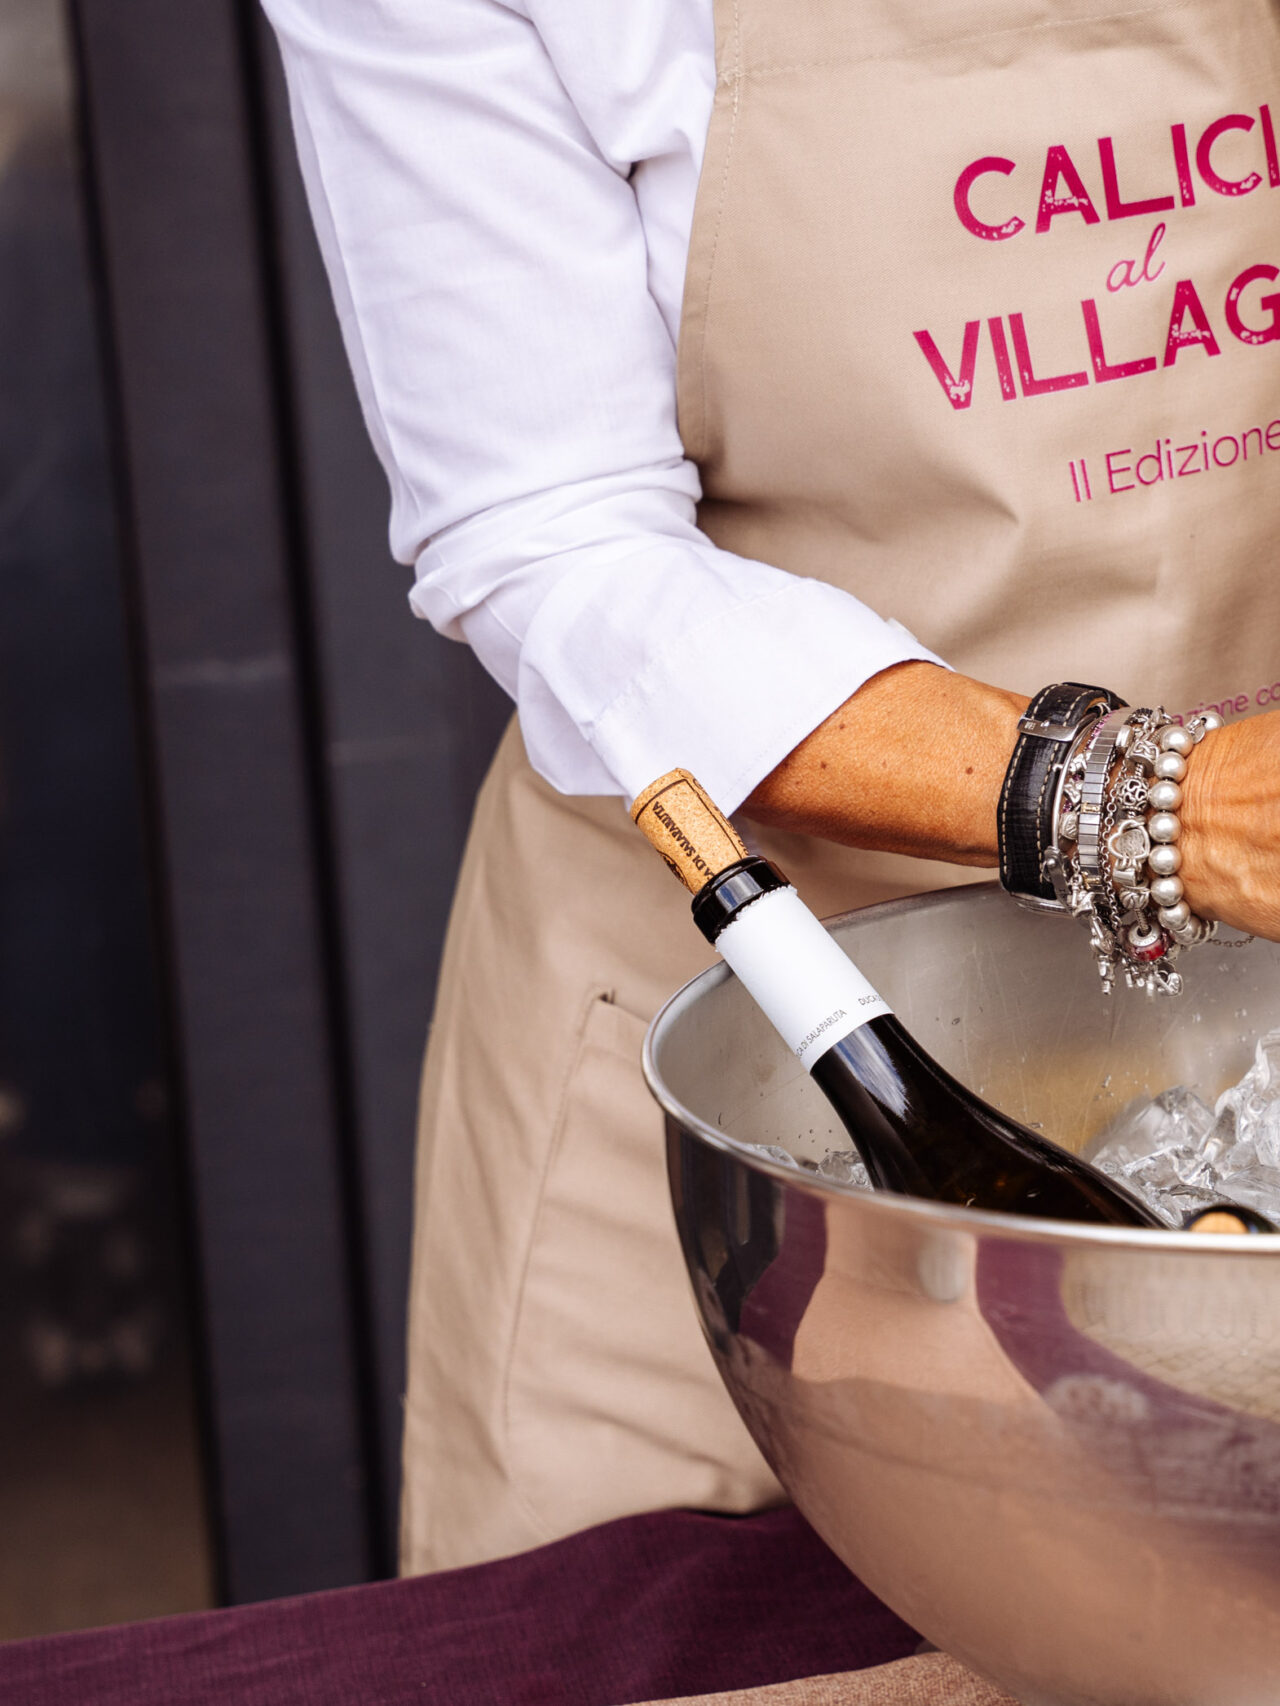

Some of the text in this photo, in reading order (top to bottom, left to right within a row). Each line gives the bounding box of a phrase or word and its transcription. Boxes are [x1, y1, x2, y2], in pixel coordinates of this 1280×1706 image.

[953, 104, 1280, 241] CALICI
[1106, 222, 1166, 293] al
[652, 801, 696, 857] SALAPARUTA
[692, 855, 706, 871] DI
[806, 1009, 847, 1044] SALAPARUTA
